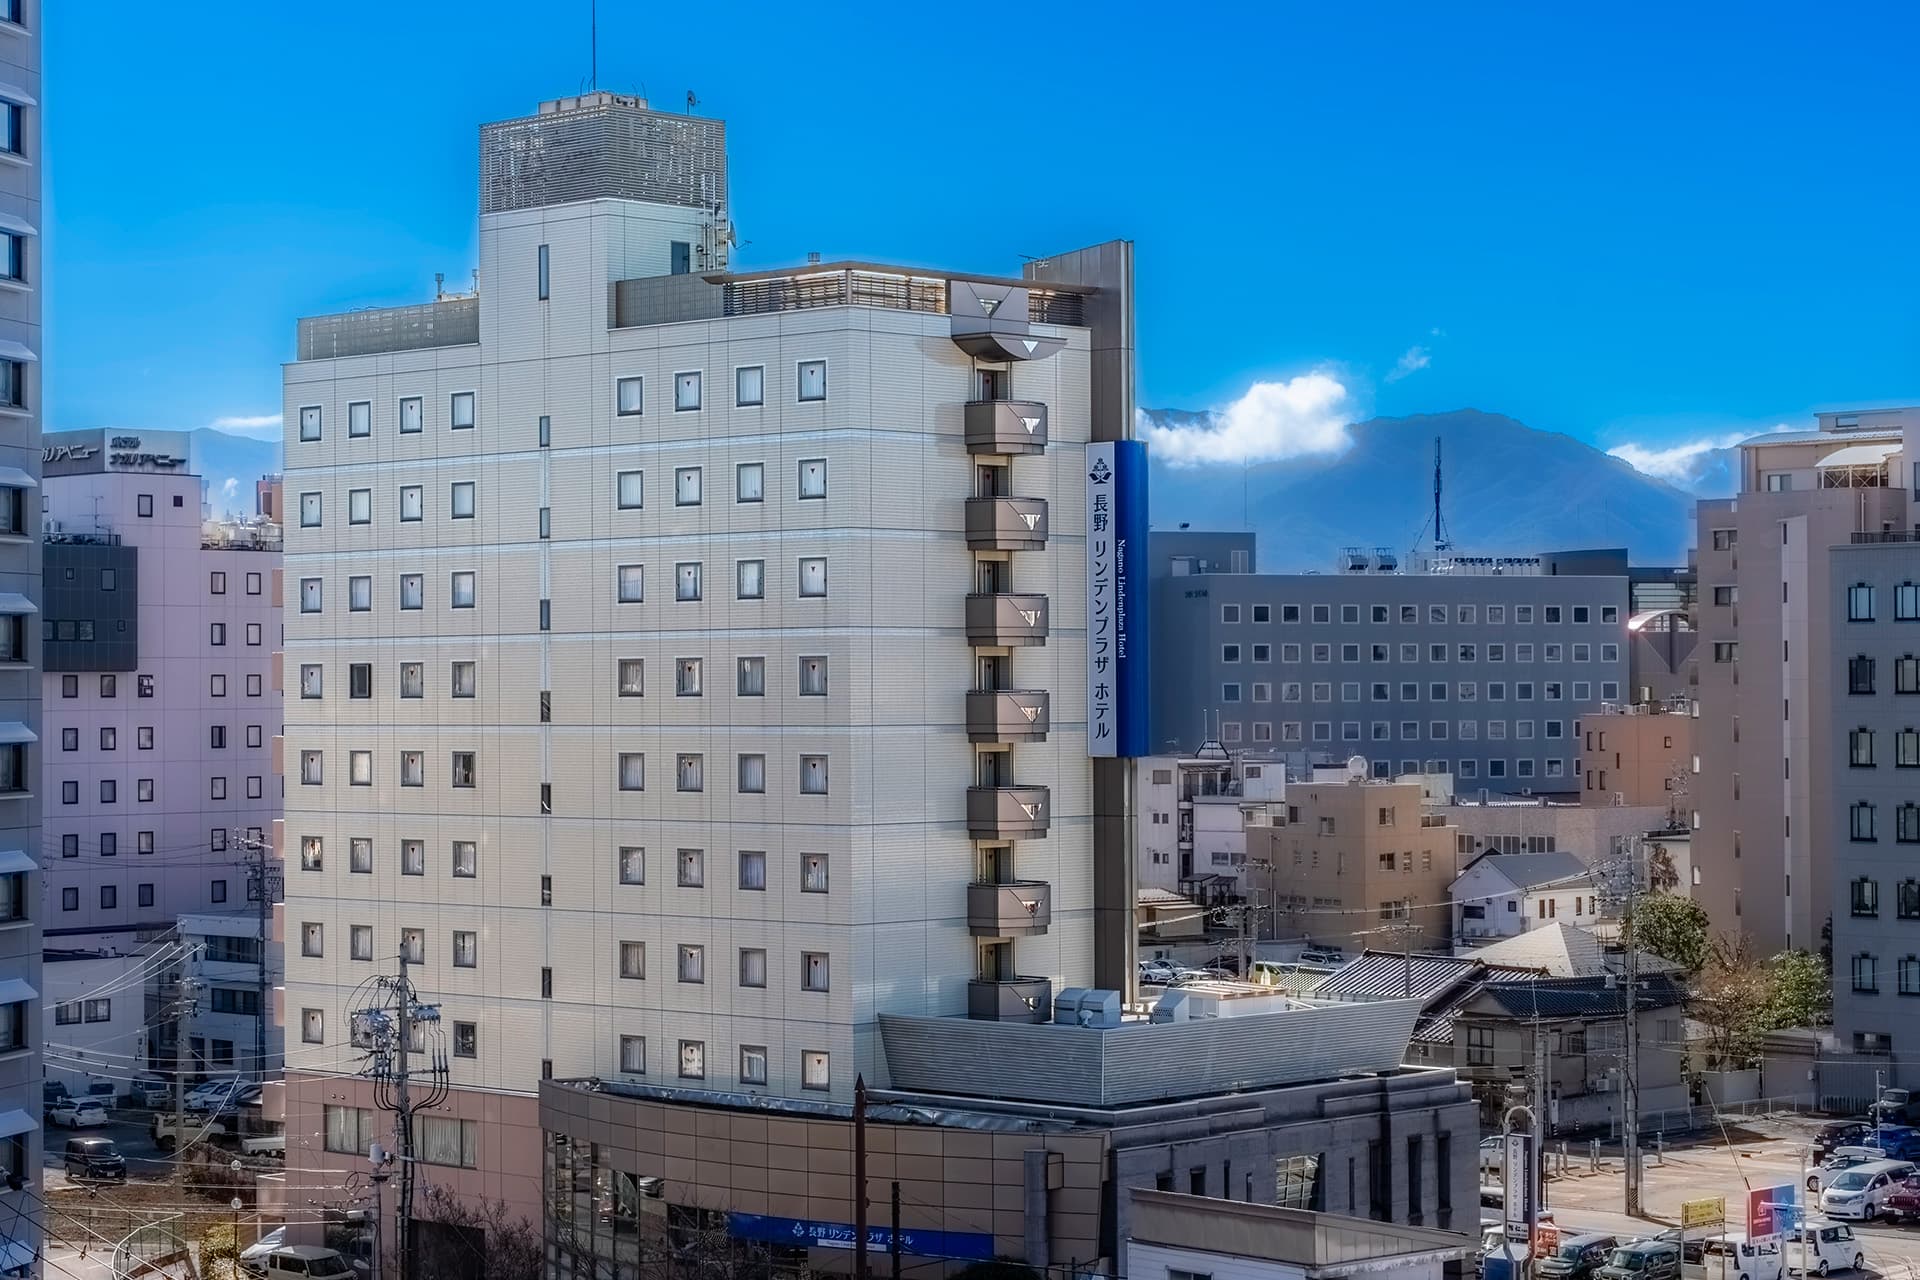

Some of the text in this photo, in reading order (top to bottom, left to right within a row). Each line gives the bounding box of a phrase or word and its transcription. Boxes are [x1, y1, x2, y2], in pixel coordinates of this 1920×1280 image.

[1093, 493, 1110, 740] 長野 リンデンプラザ ホテル
[1116, 539, 1127, 659] Nagano Lindenplaza Hotel
[809, 1226, 826, 1238] 長野
[829, 1229, 884, 1243] リンデンラザ
